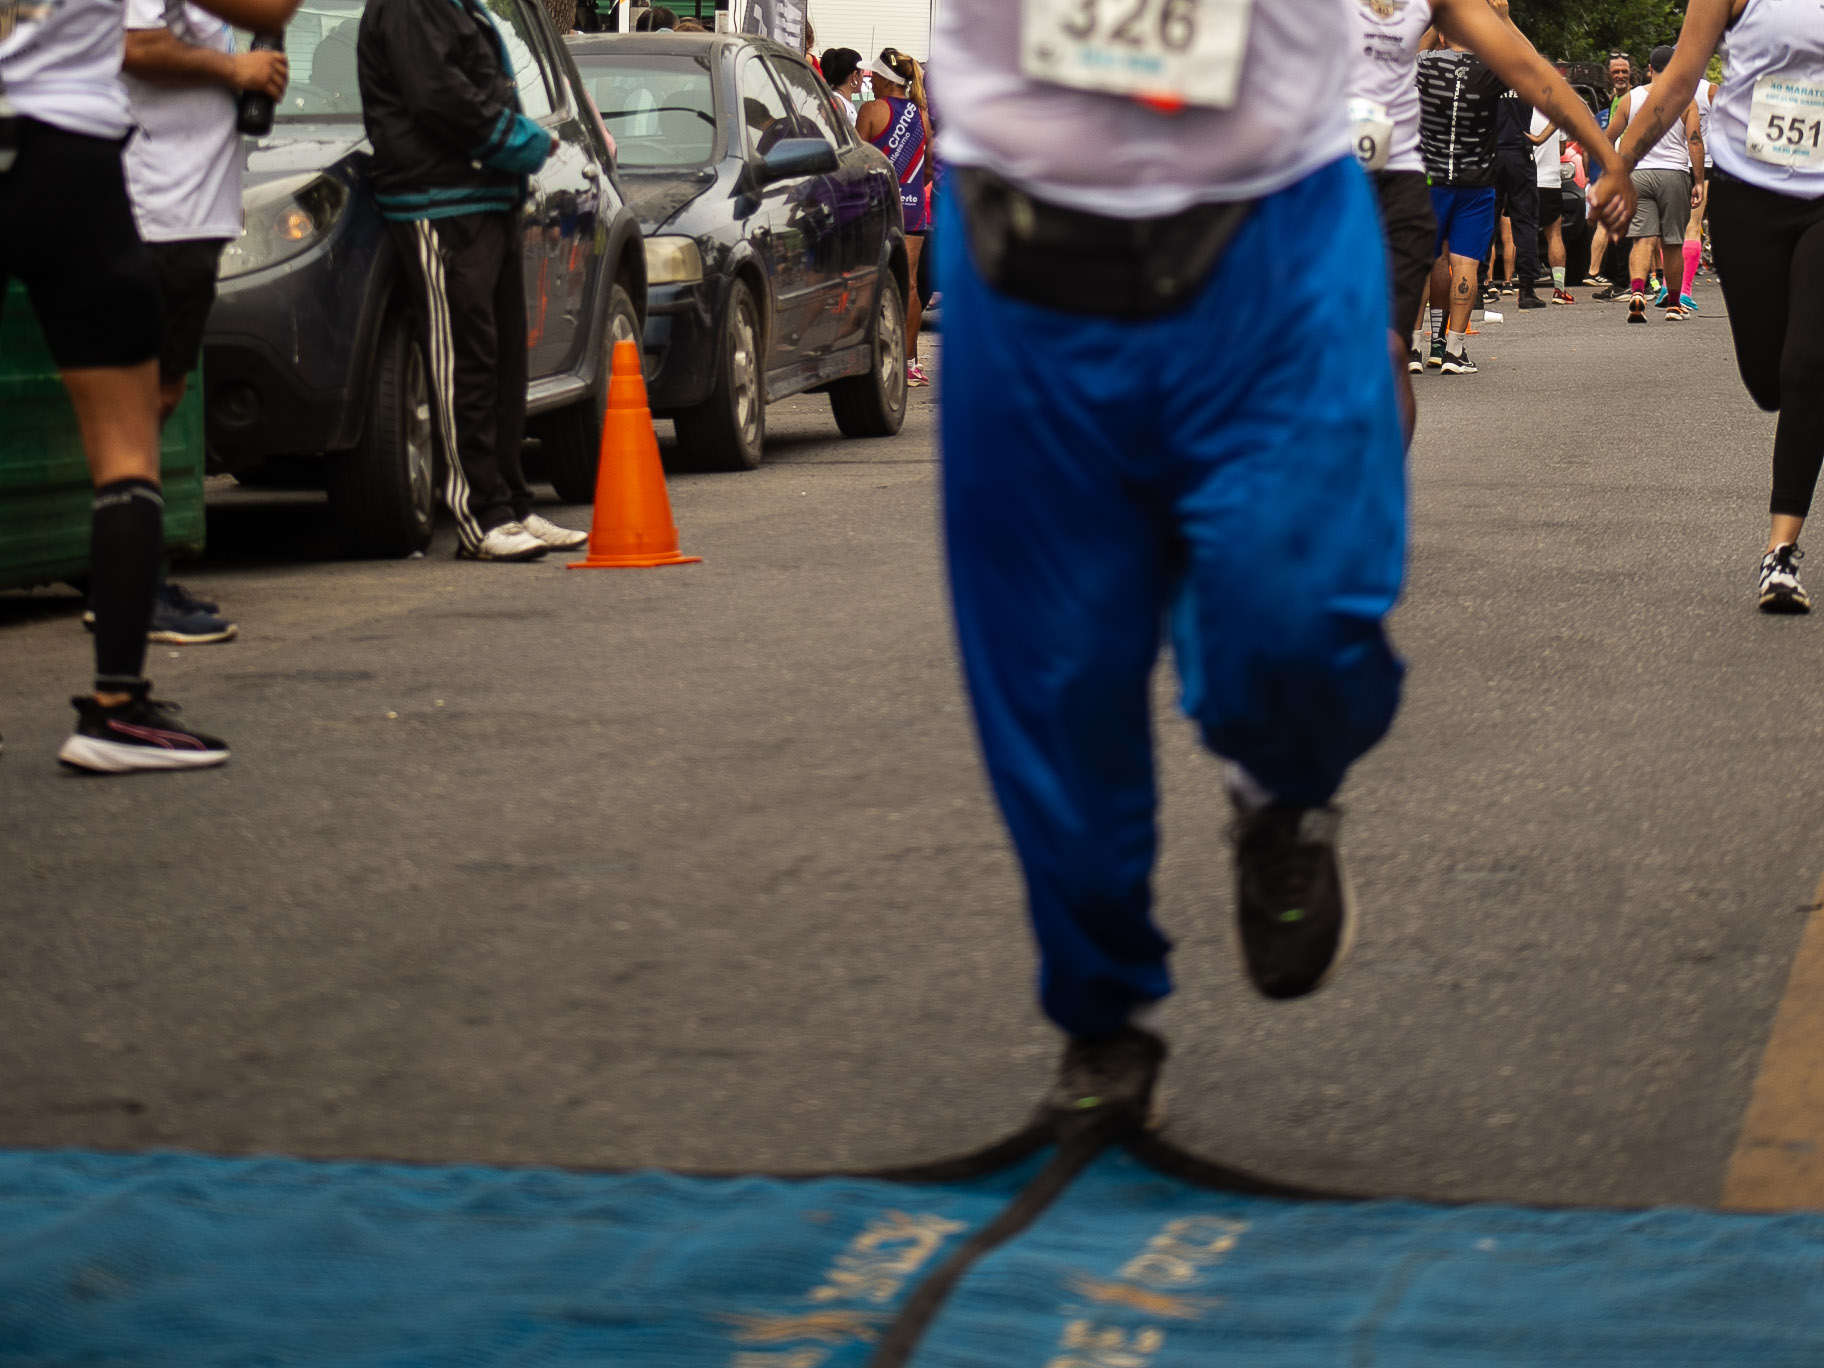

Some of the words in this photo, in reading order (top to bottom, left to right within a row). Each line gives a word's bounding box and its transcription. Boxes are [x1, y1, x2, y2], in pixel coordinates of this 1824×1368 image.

[889, 102, 917, 149] cronos
[1765, 114, 1821, 149] 551
[890, 132, 911, 164] tletismo
[900, 195, 918, 203] erto
